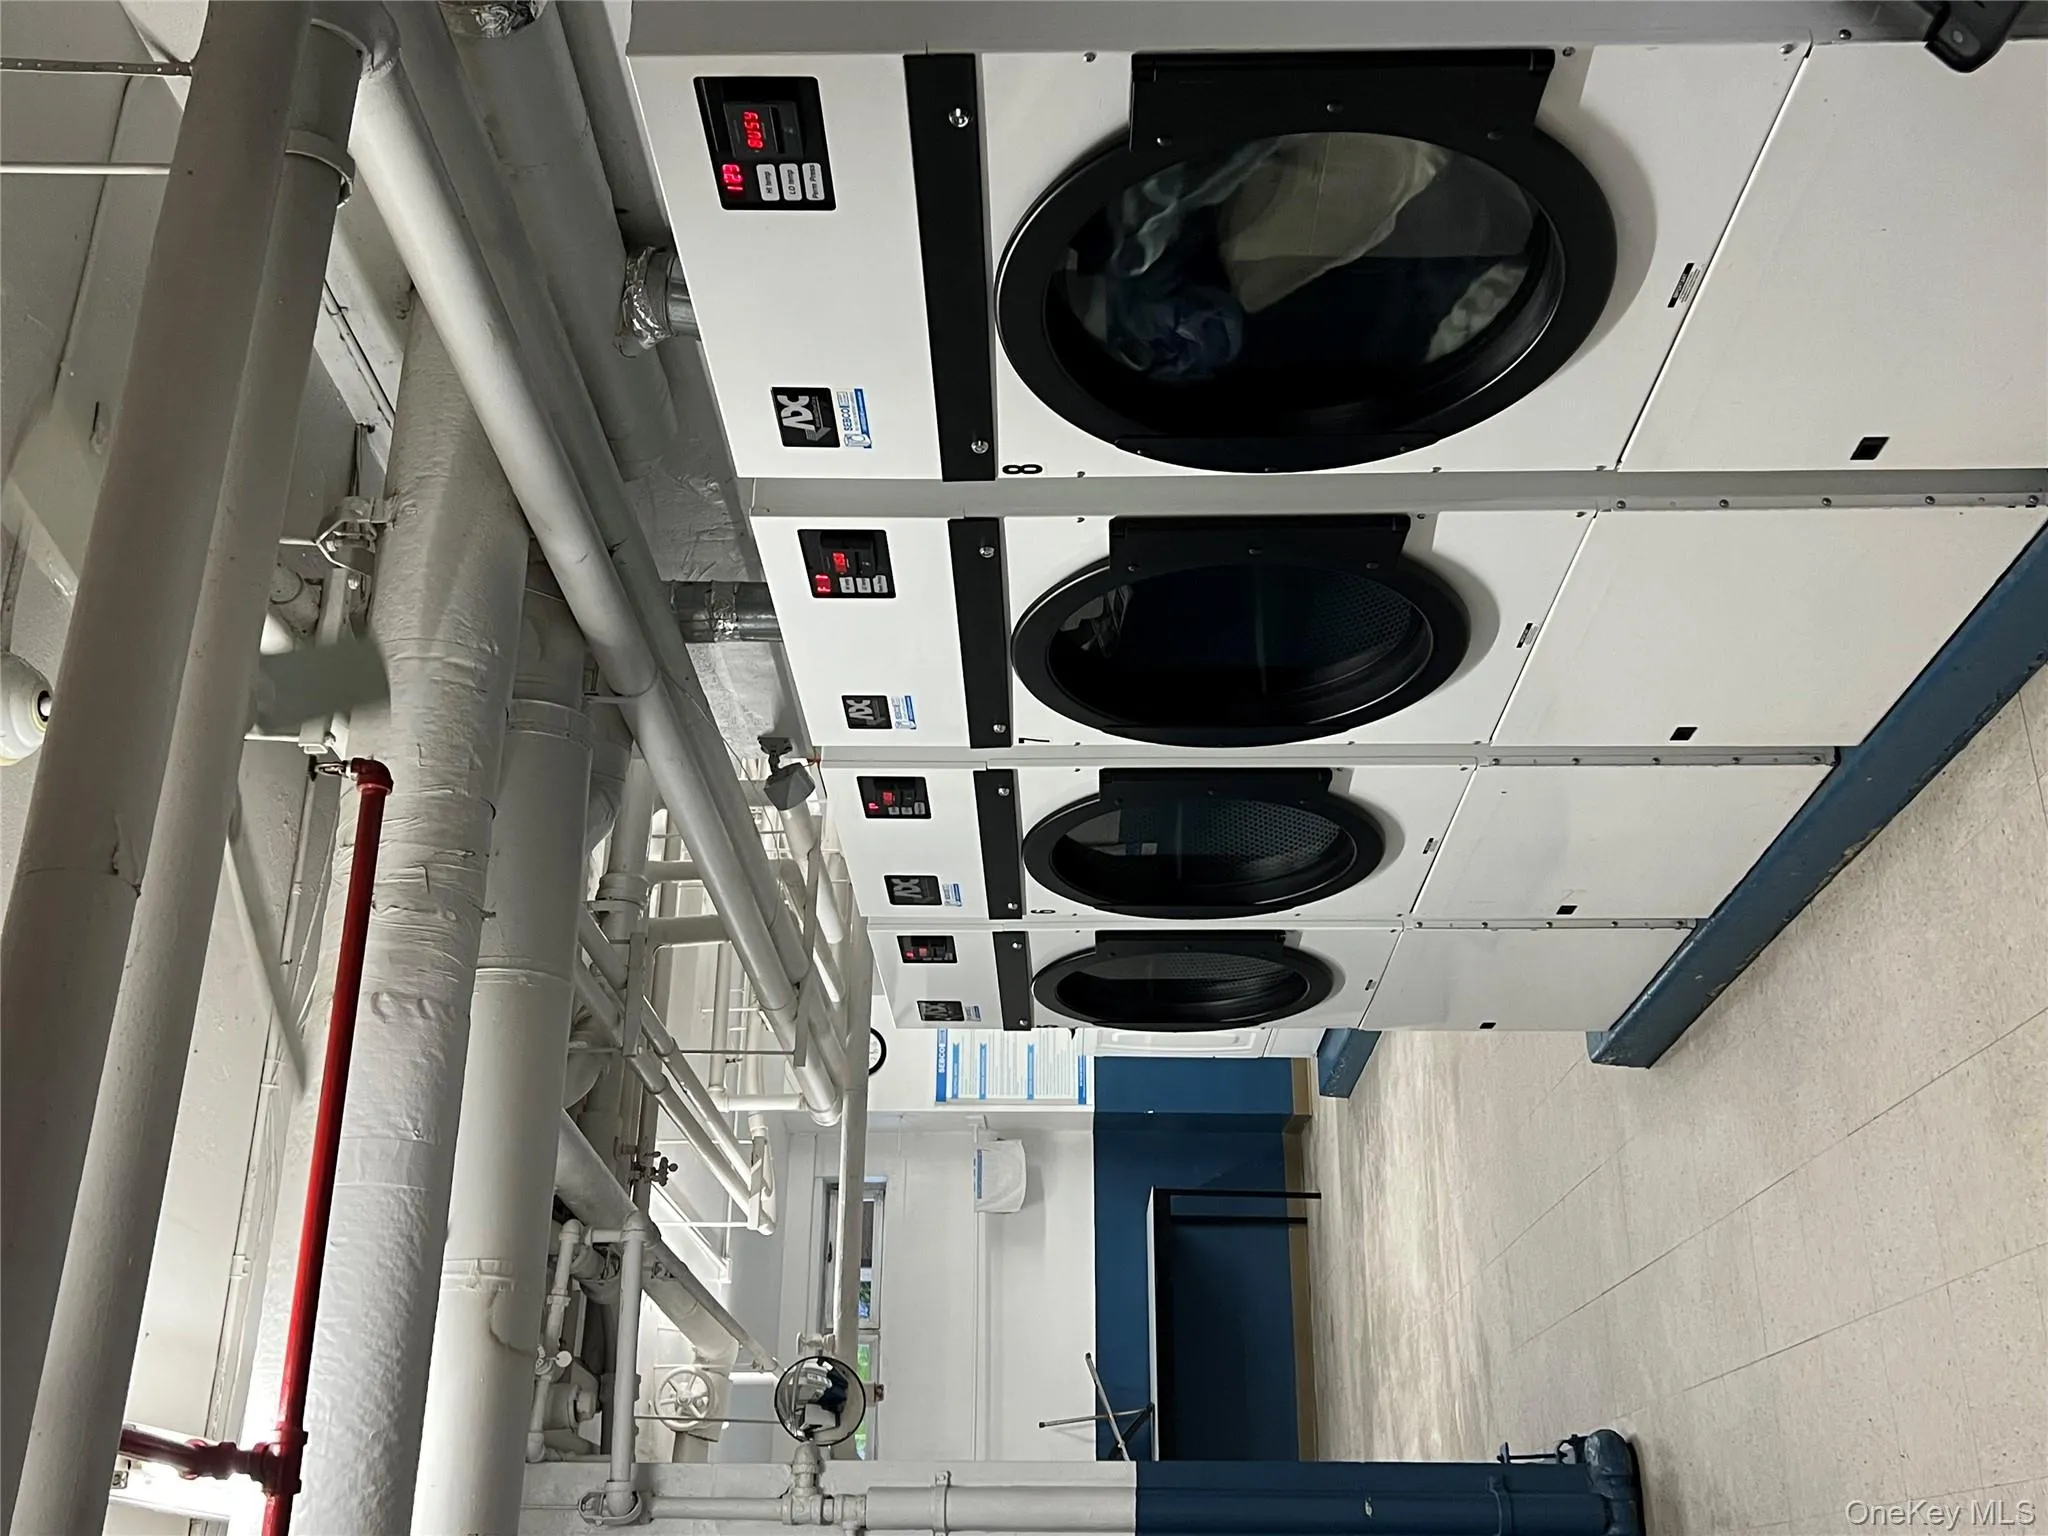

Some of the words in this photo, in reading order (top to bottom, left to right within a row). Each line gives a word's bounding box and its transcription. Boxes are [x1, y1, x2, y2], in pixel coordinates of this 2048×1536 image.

[722, 164, 744, 192] 123
[808, 164, 816, 182] Press
[810, 183, 819, 198] Perm
[1002, 464, 1042, 474] 8
